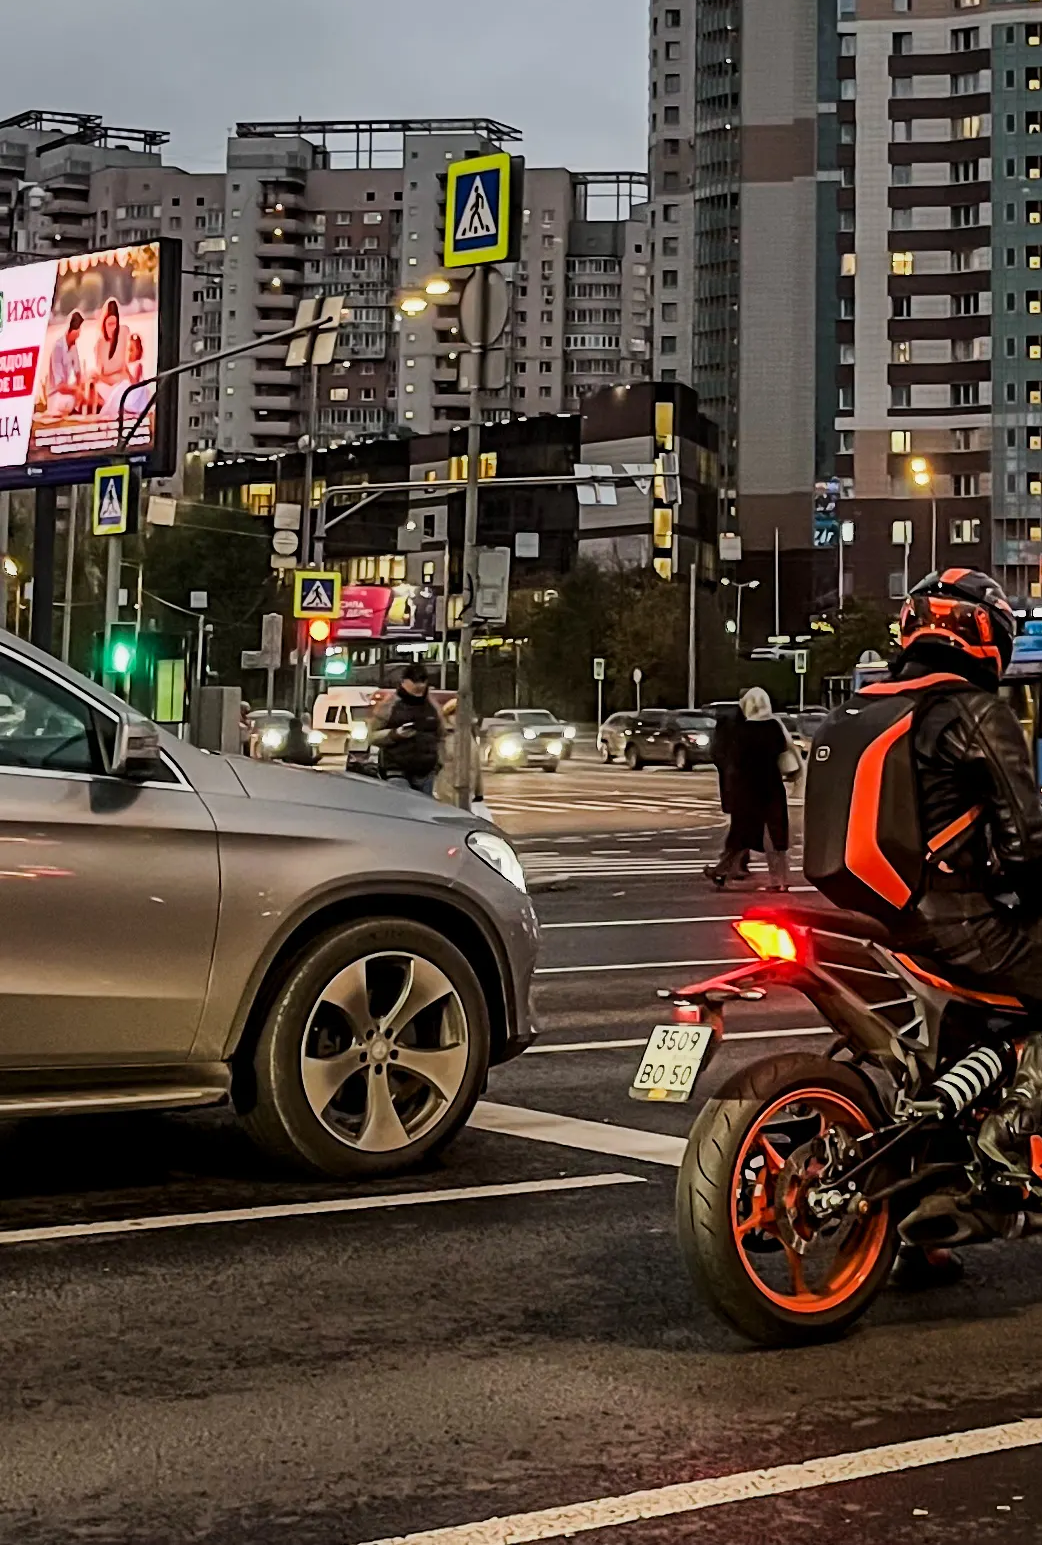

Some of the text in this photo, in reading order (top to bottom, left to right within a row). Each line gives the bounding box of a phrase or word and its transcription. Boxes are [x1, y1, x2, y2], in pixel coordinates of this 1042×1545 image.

[6, 295, 47, 323] ИЖС
[656, 1029, 701, 1051] 3509
[669, 1065, 692, 1085] 50
